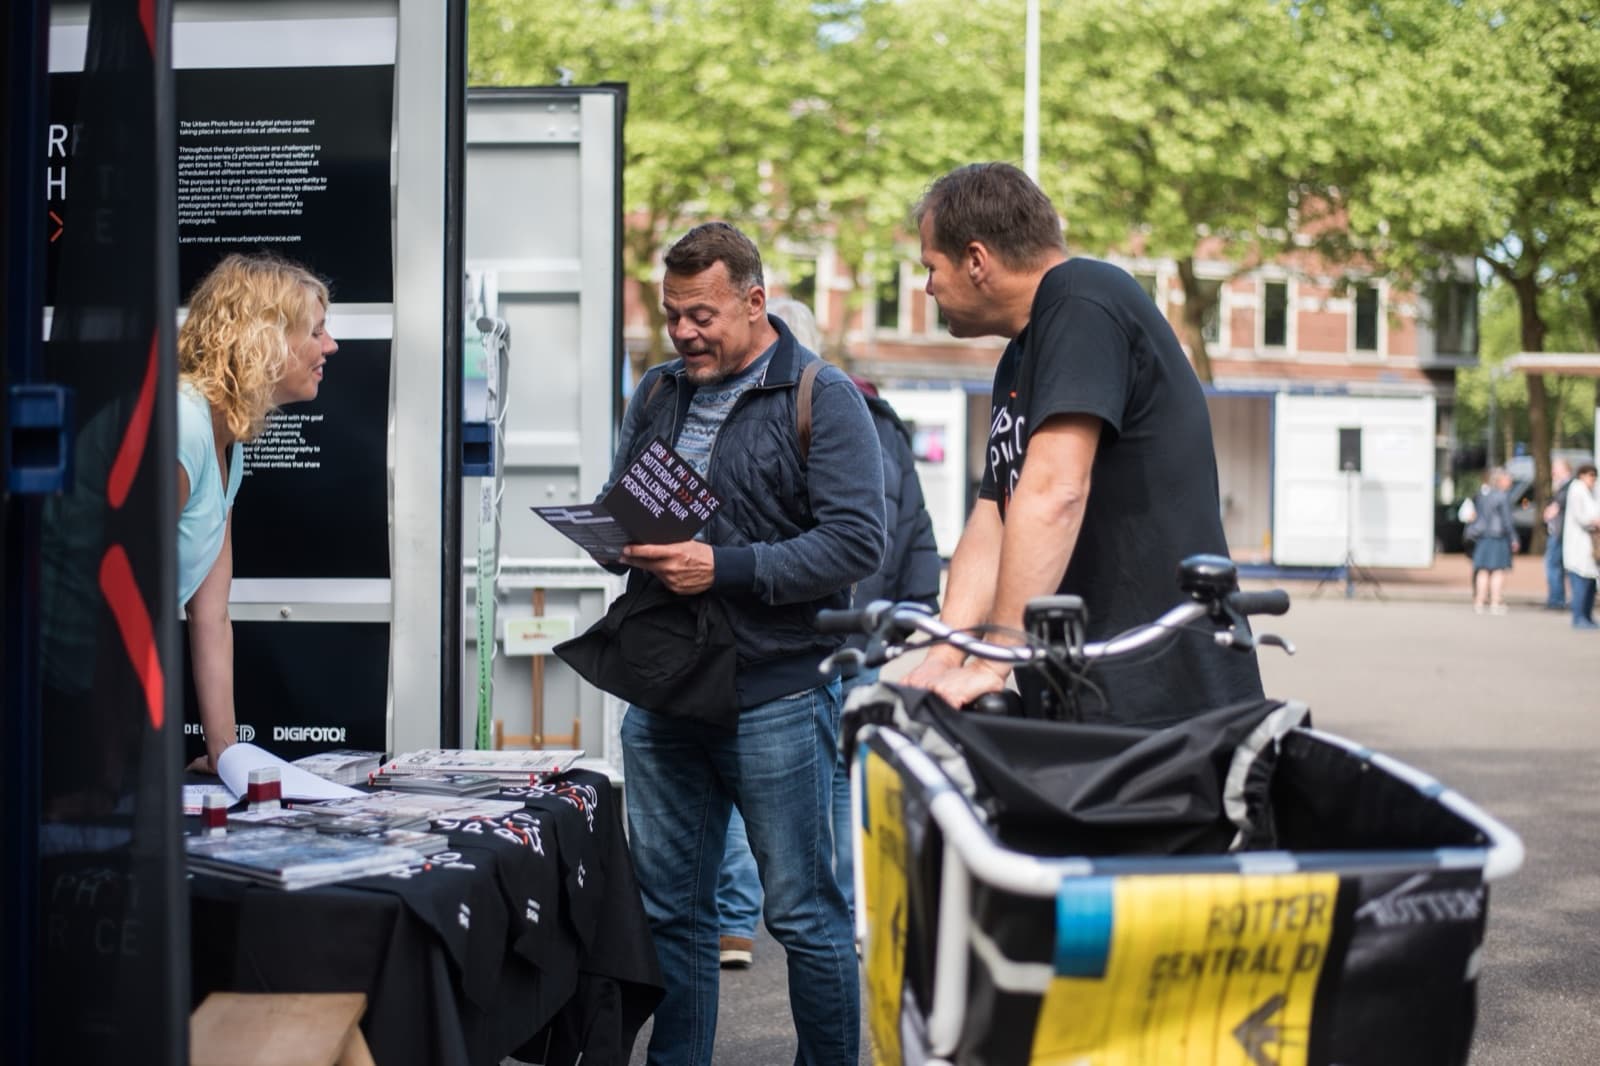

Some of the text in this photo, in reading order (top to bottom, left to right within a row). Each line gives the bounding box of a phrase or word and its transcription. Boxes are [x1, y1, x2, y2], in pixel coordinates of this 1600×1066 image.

[630, 463, 688, 520] CHALLENGE YOUR
[640, 452, 681, 492] ROTTERDAM
[620, 474, 664, 518] PERSPECTIVE
